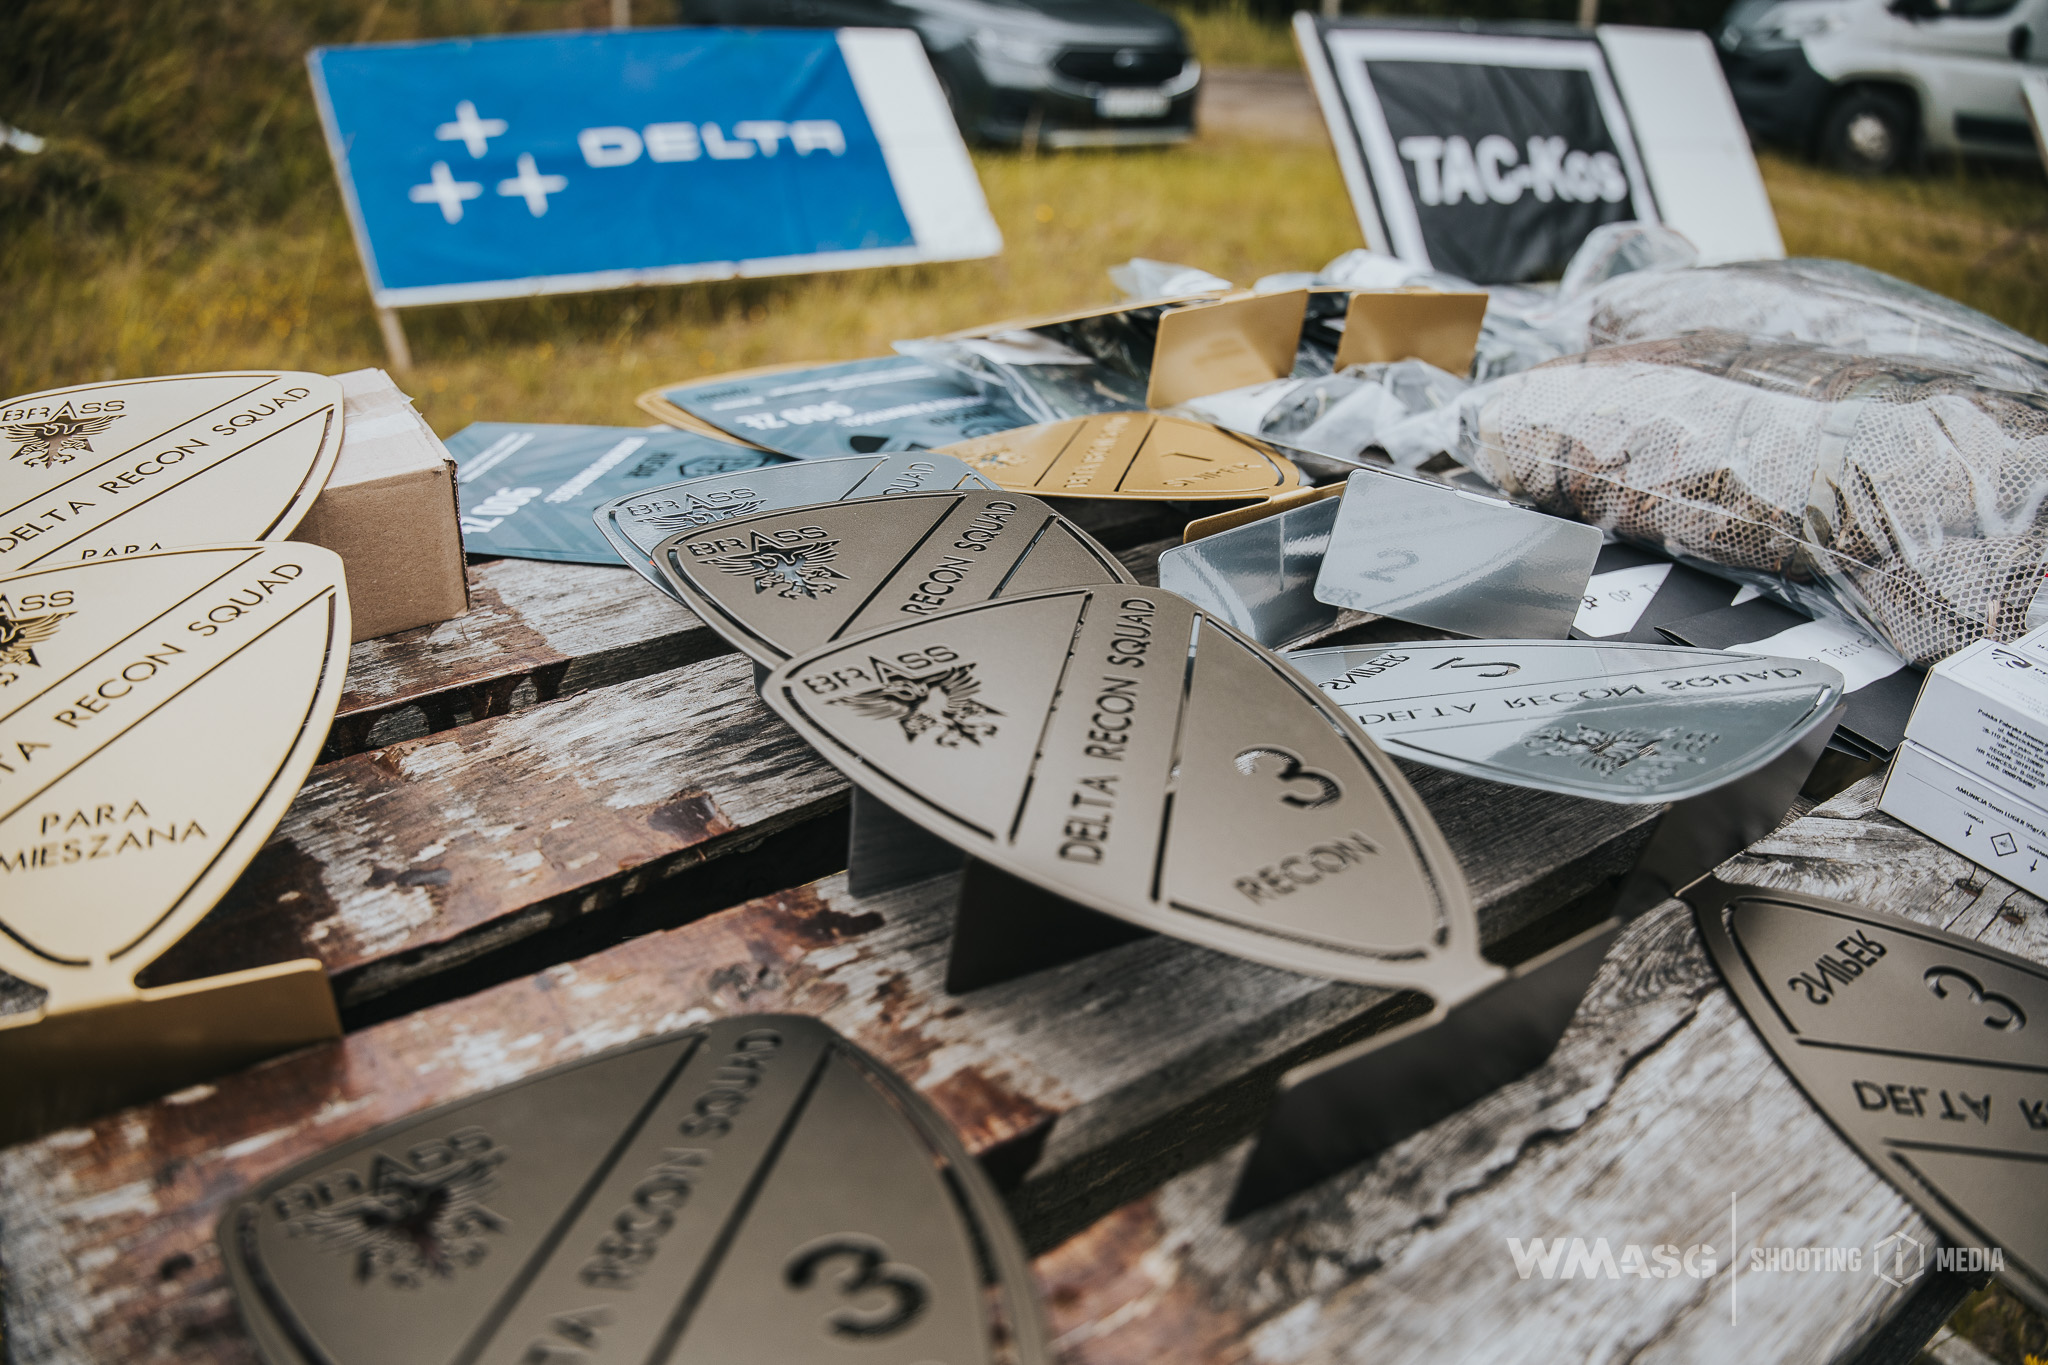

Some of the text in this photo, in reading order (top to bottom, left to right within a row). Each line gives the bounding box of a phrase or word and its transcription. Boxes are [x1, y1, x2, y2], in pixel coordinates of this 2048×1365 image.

[578, 120, 846, 168] DELTA
[0, 386, 311, 553] DELTA RECON SQUAD
[626, 488, 757, 516] BRASS
[686, 525, 828, 557] BRASS
[900, 555, 976, 615] RECON
[954, 501, 1017, 552] SQUAD
[54, 562, 304, 728] RECON SQUAD
[803, 645, 960, 694] BRASS
[1058, 598, 1156, 865] DELTA RECON SQUAD
[1977, 708, 1998, 722] Polska
[1999, 719, 2022, 735] Fabryka
[1234, 746, 1342, 810] 3
[1956, 785, 1988, 806] AMUNICJA
[1988, 802, 2004, 815] 9mm
[2004, 811, 2026, 826] LUGER
[0, 820, 207, 872] MIESZANA
[41, 800, 149, 835] PARA
[1234, 832, 1382, 905] RECON
[578, 1028, 783, 1292] RECON SQUAD
[784, 1238, 932, 1340] 3
